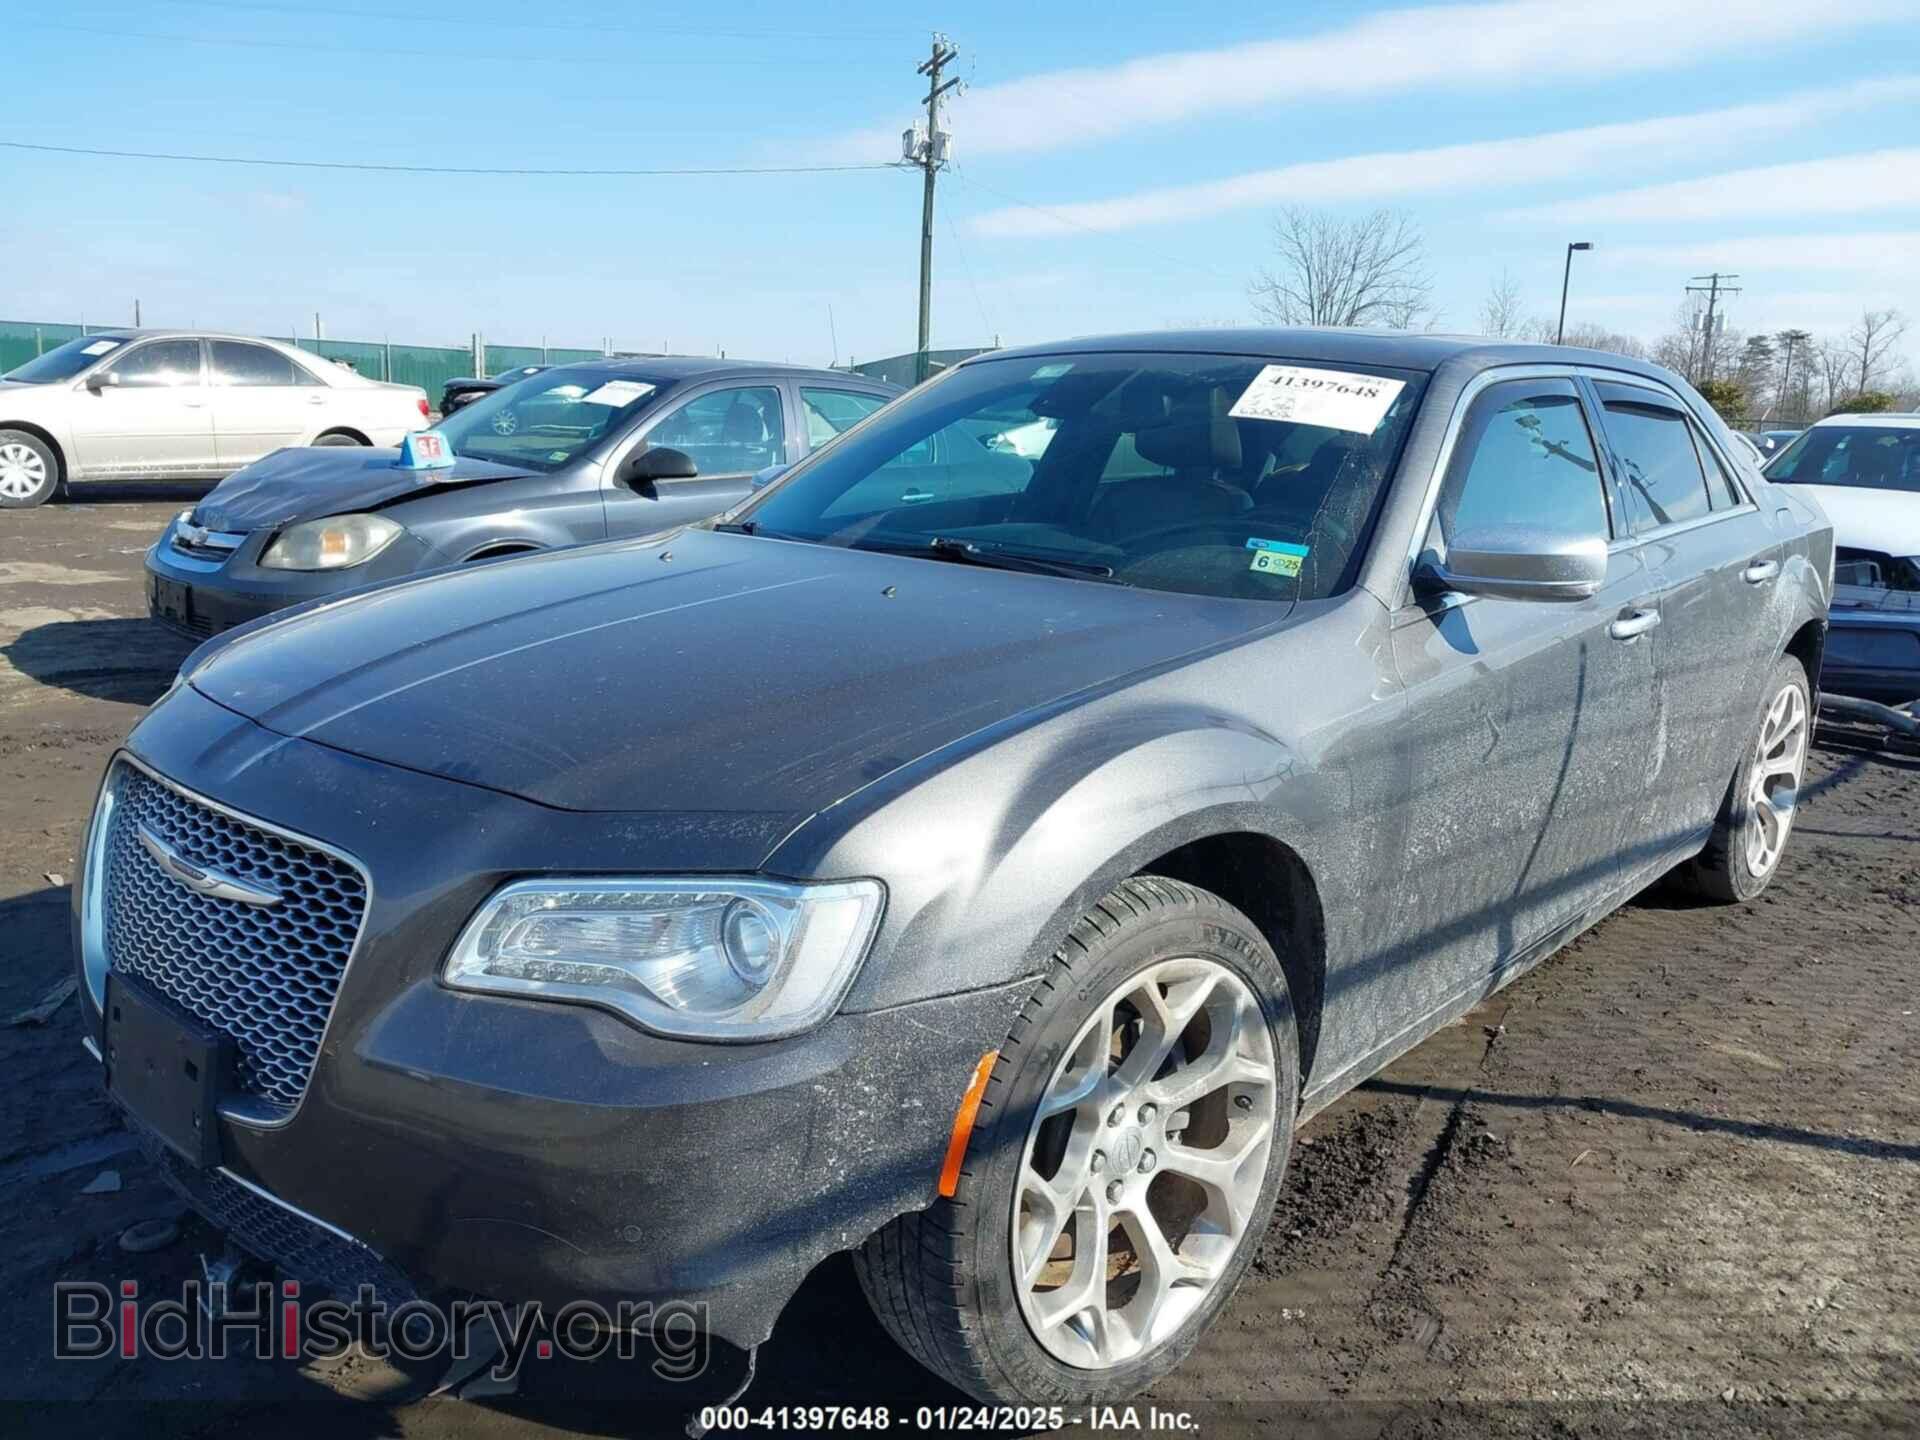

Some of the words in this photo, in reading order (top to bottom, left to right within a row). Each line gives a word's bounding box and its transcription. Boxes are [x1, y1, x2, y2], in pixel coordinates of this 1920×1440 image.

[1269, 375, 1380, 399] 41397648
[1257, 555, 1270, 568] 6
[1284, 559, 1299, 570] 25
